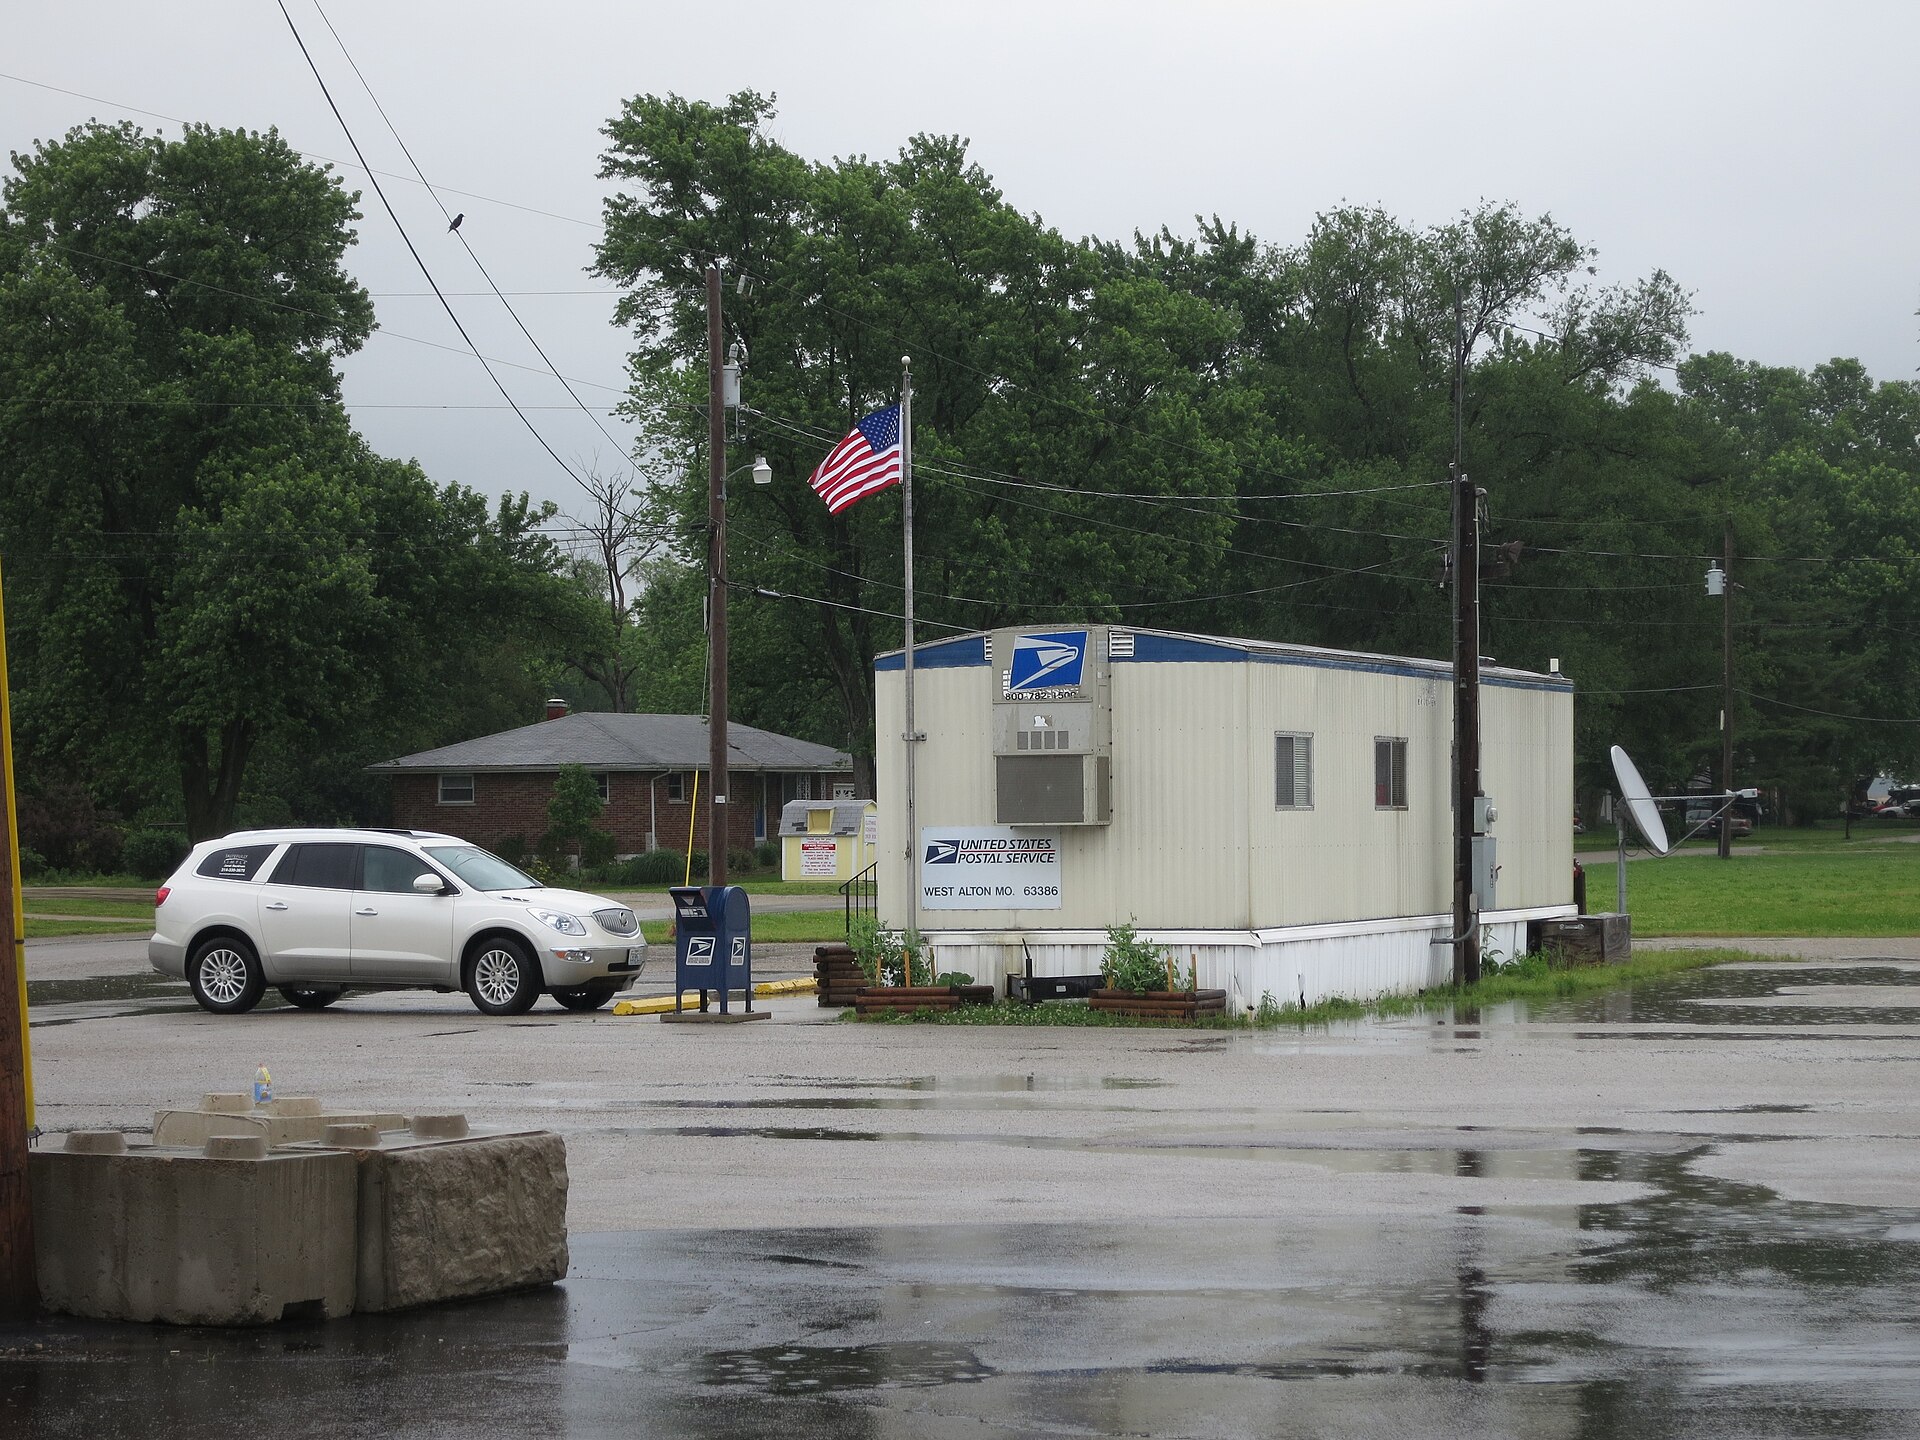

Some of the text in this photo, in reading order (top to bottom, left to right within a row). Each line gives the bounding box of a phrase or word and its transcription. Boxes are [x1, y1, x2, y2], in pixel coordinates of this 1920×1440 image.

[960, 839, 1052, 850] UNITED STATES
[958, 852, 1054, 864] POSTAL SERVICE
[924, 886, 1059, 896] WEST ALTON MO. 63386
